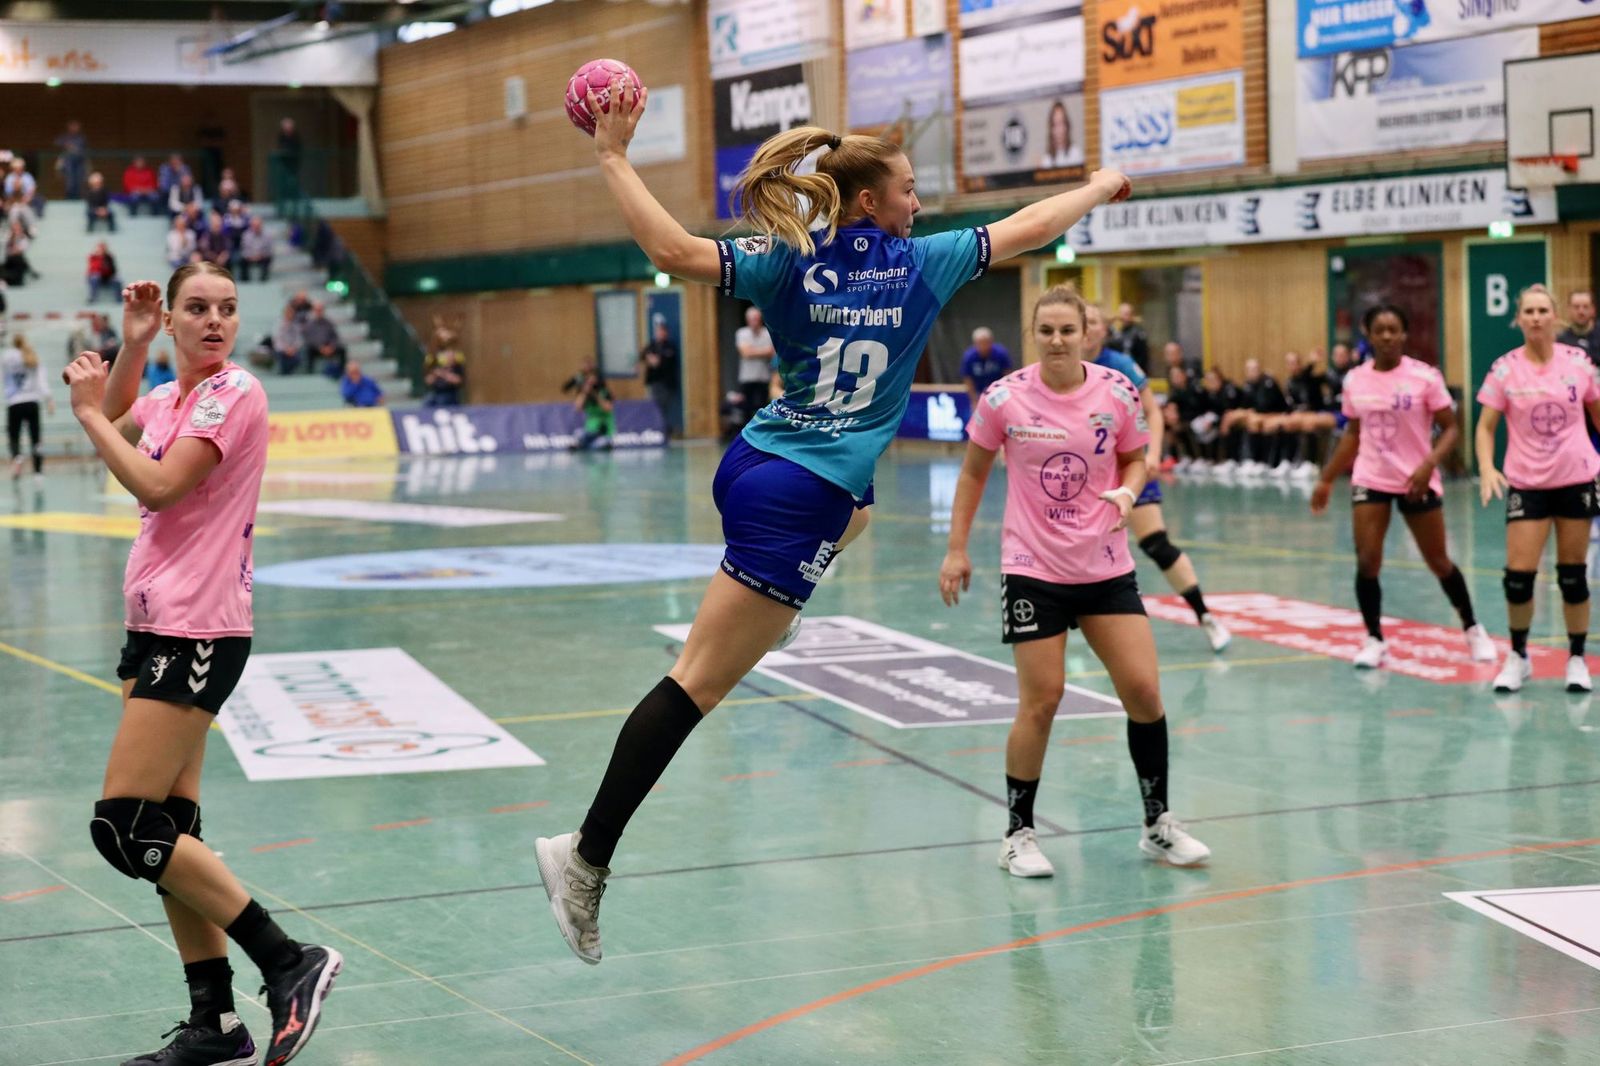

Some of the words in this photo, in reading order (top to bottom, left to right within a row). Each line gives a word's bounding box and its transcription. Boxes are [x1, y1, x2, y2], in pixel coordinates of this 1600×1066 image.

[1331, 187, 1376, 213] ELBE
[1384, 177, 1487, 208] KLINIKEN
[980, 236, 988, 262] Kempa
[1486, 273, 1509, 317] B
[809, 304, 902, 328] Winterberg
[807, 336, 889, 416] 13
[1567, 385, 1577, 402] 3
[294, 422, 374, 442] LOTTO
[402, 408, 498, 454] hit.
[1094, 427, 1108, 455] 2
[1044, 471, 1086, 483] BAYER
[1061, 456, 1072, 499] BAYER
[738, 570, 762, 588] Kempa
[767, 586, 790, 602] Kempa
